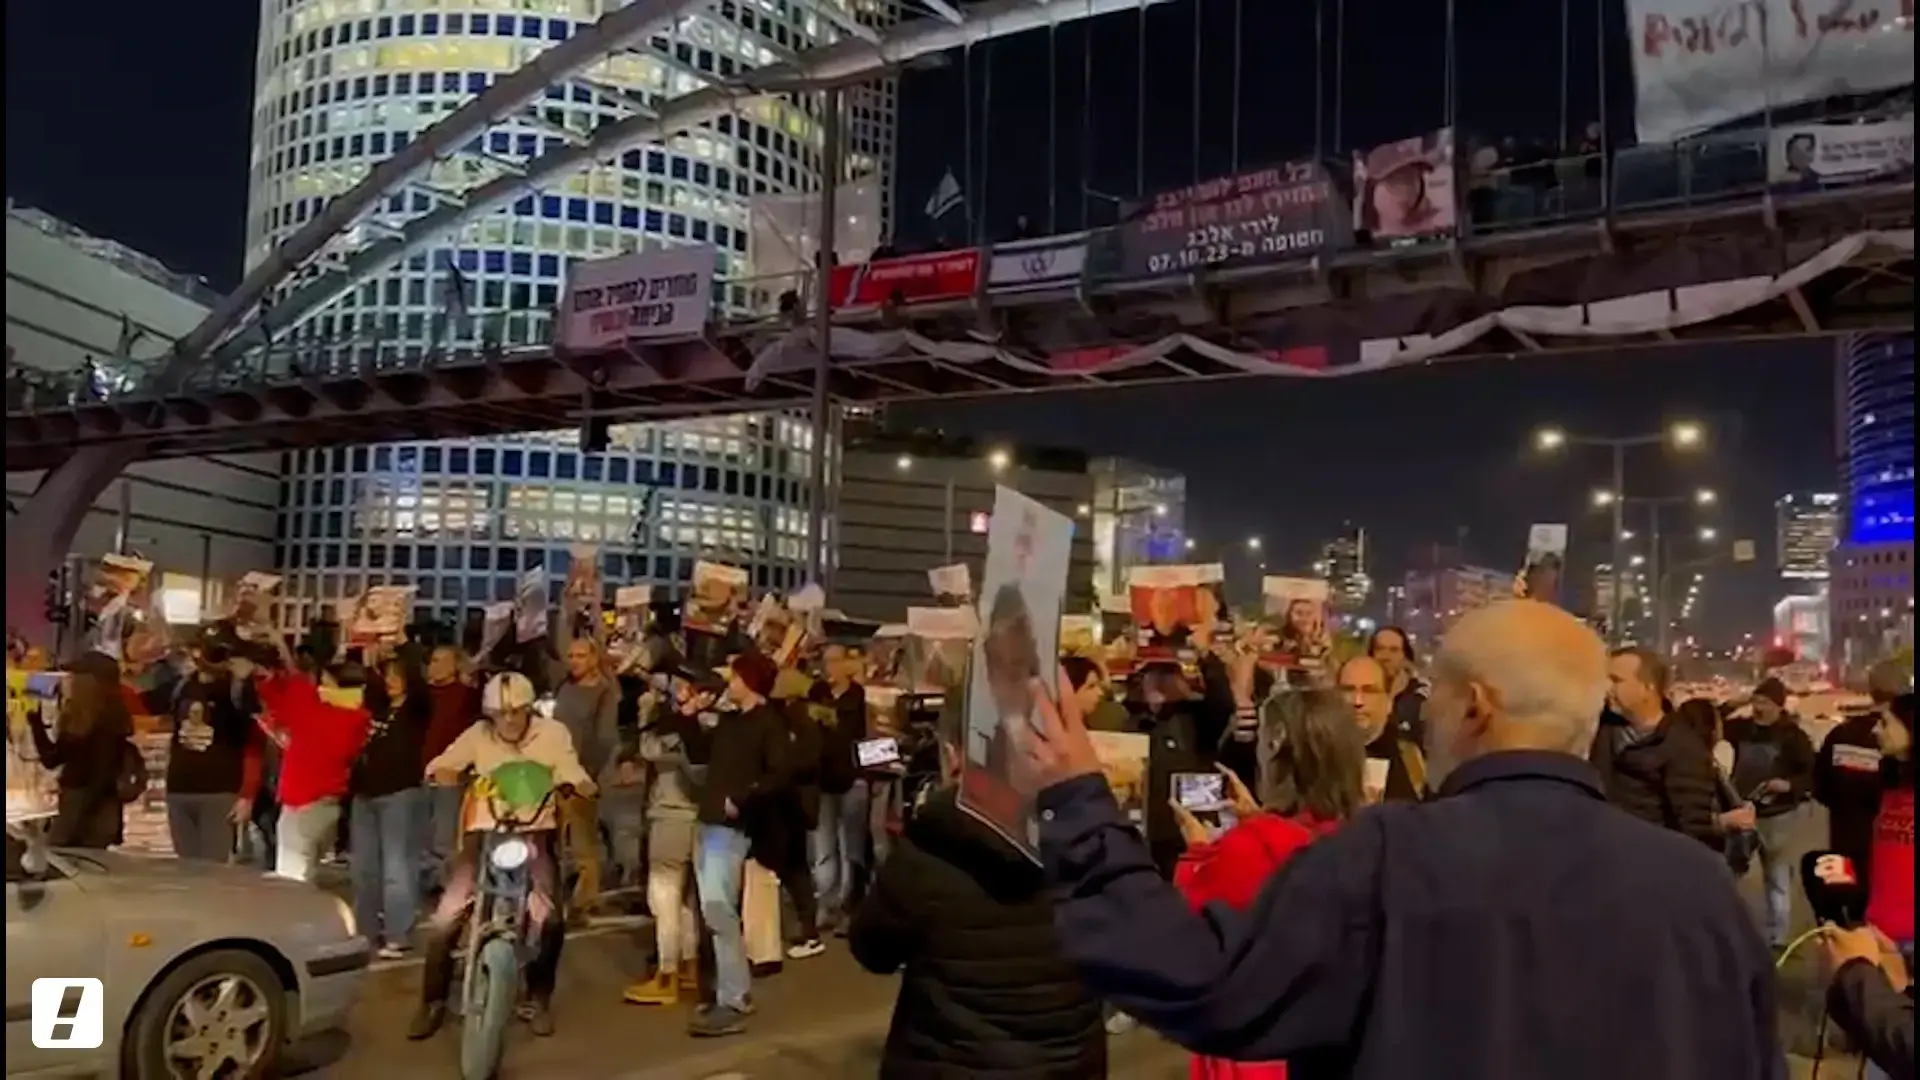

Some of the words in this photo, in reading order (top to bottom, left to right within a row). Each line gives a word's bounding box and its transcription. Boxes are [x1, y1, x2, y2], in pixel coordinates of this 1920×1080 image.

[1240, 213, 1280, 235] לירי
[1187, 225, 1235, 247] אלבג
[1262, 229, 1323, 252] חטופה
